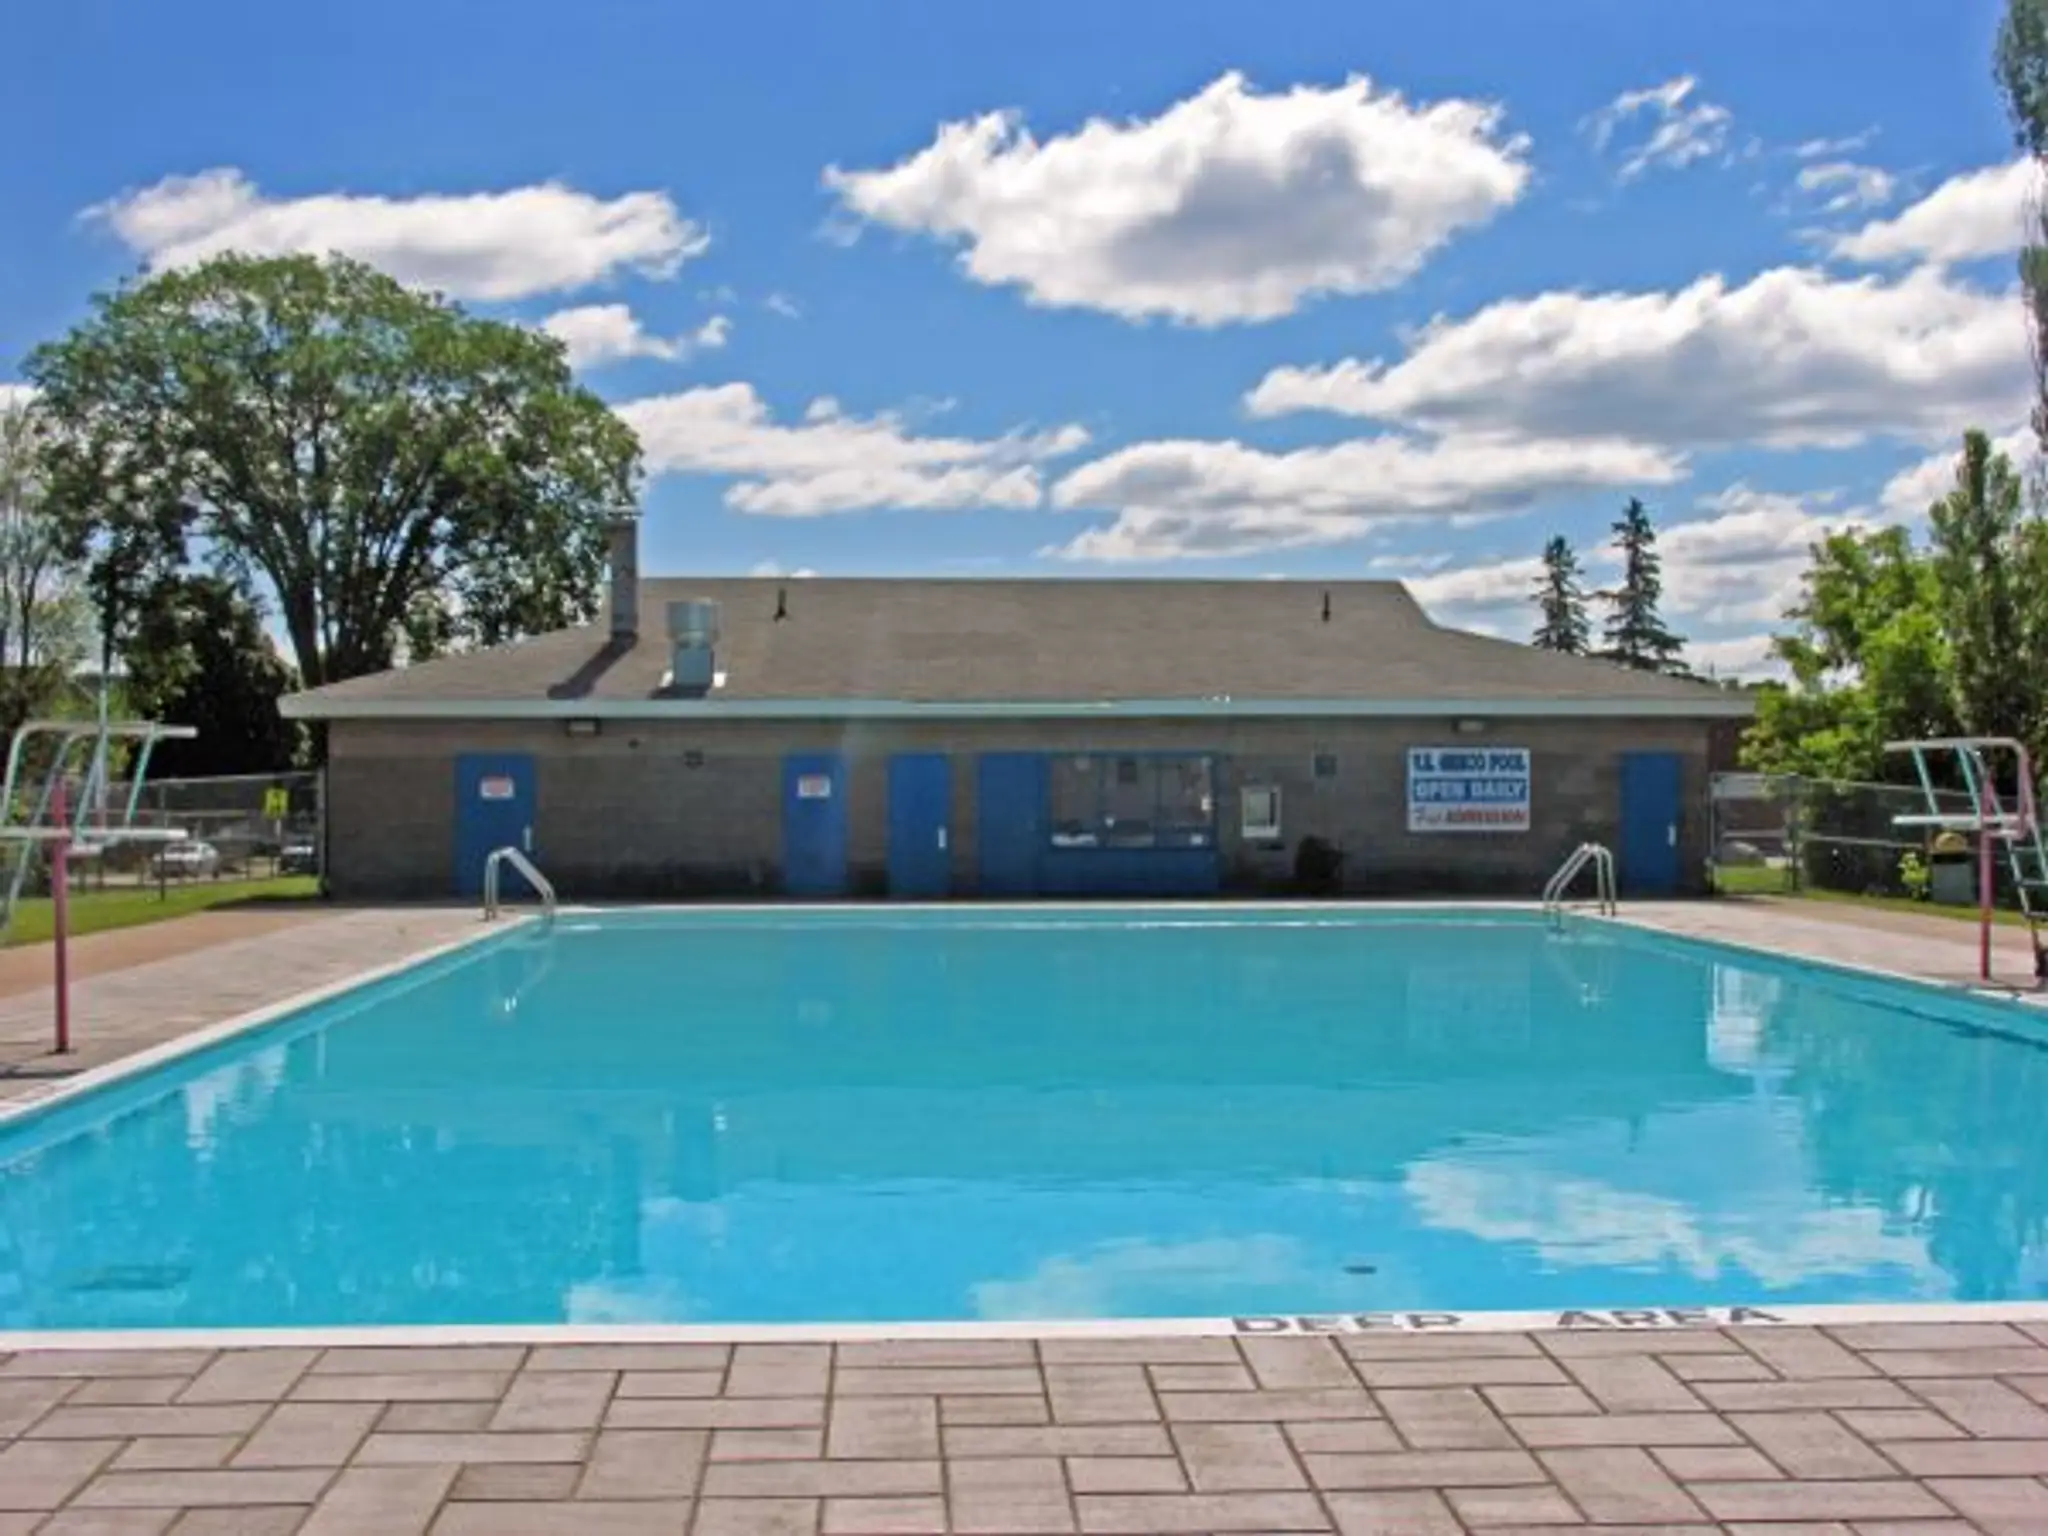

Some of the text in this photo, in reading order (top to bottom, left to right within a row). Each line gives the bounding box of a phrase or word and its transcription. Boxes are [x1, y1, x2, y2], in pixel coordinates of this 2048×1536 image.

[1415, 780, 1524, 798] OPEN DAILY
[1231, 1306, 1788, 1333] DEEP AREA
